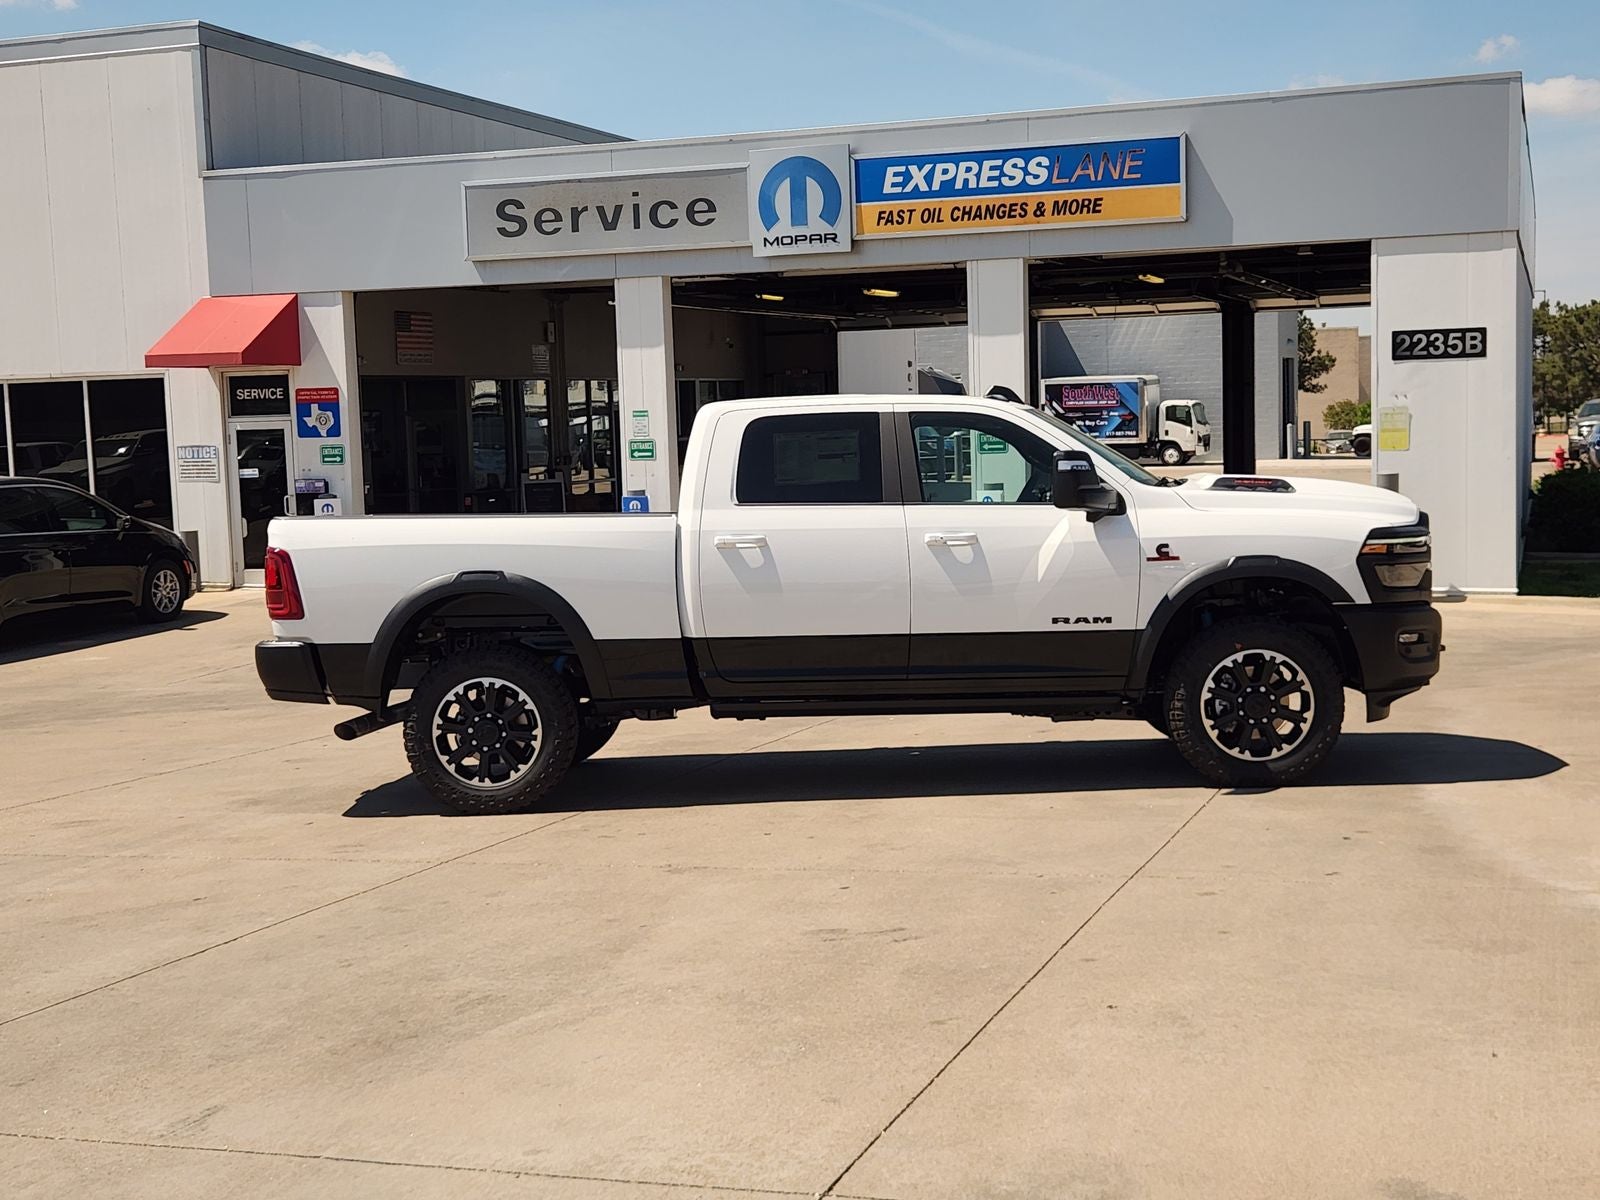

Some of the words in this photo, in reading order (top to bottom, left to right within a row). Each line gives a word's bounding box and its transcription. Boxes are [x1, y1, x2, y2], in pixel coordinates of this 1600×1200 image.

[496, 191, 717, 238] Service
[876, 208, 916, 226] FAST
[922, 206, 945, 224] OIL
[950, 201, 1029, 221] CHANGES
[1034, 201, 1046, 218] &
[1051, 197, 1104, 217] MORE
[763, 233, 840, 247] MOPAR
[1395, 331, 1483, 356] 2235B
[236, 388, 284, 400] SERVICE
[177, 446, 217, 459] NOTICE
[1051, 616, 1113, 625] RAM
